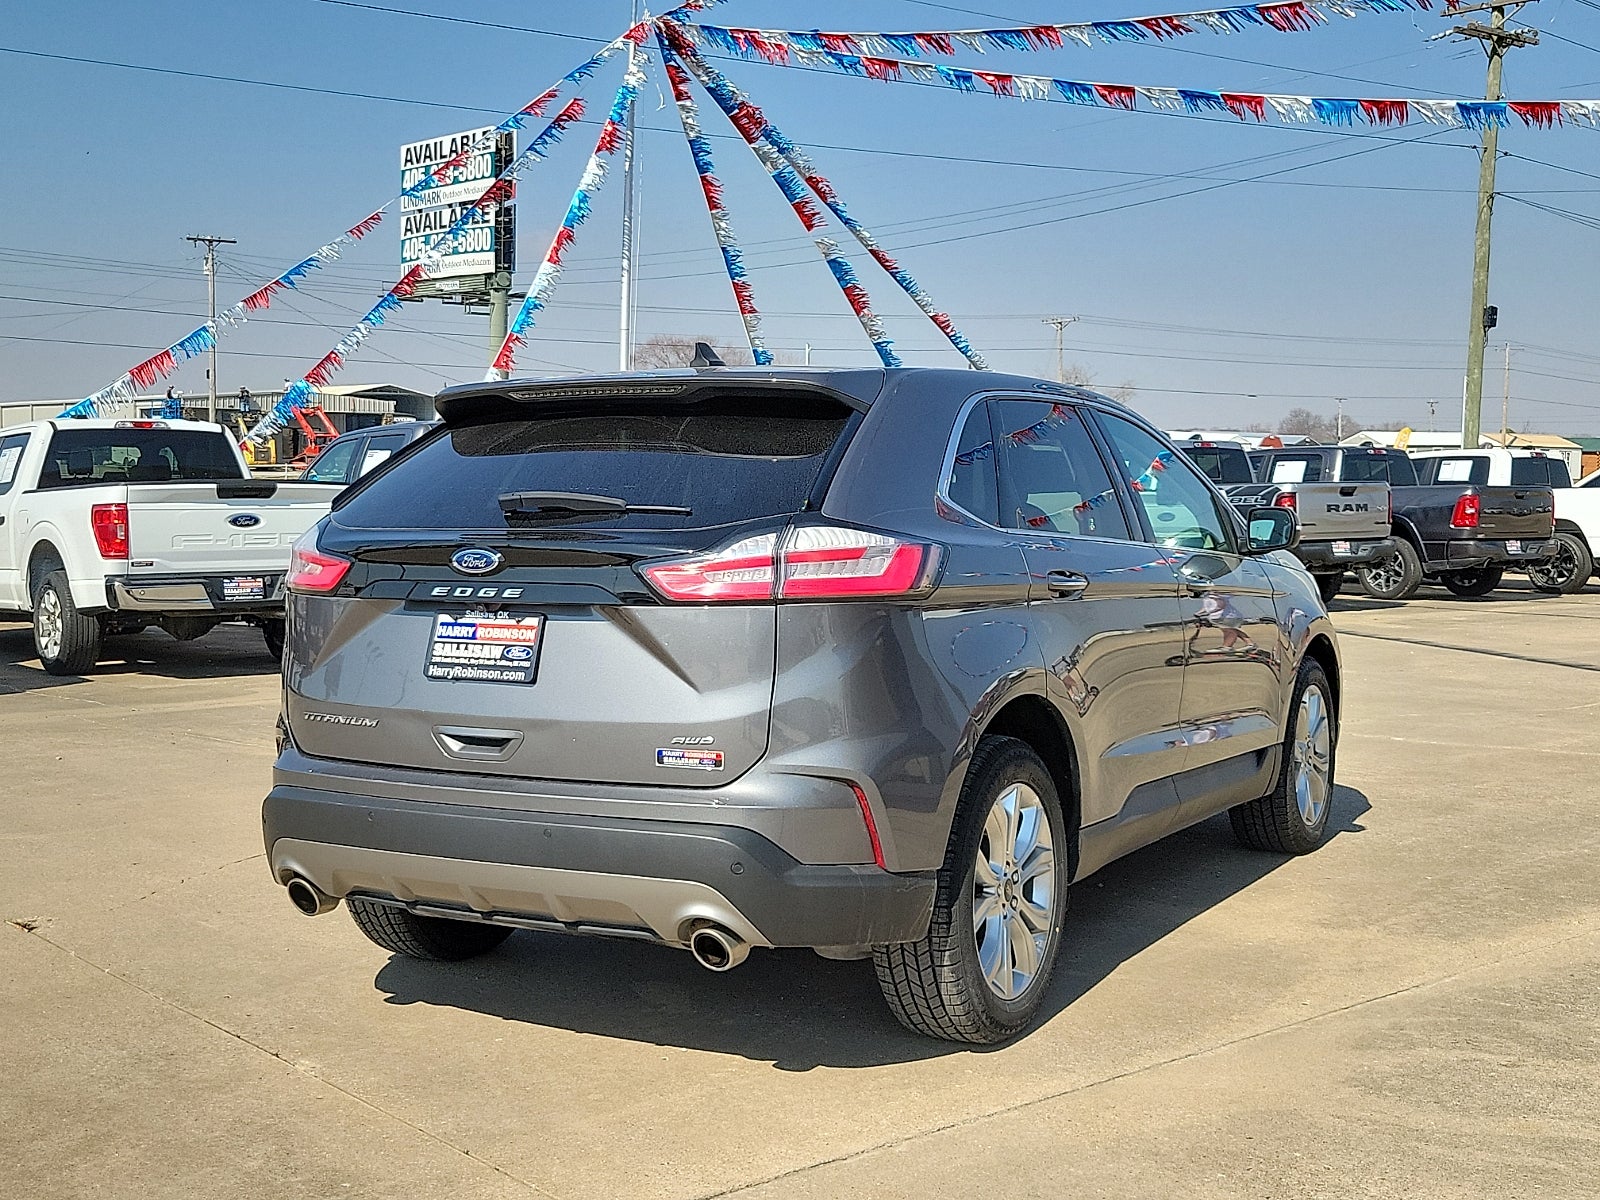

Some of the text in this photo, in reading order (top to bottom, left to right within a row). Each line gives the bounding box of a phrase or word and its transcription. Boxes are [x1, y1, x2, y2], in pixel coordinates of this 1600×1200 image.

[404, 129, 492, 167] AVAILABLE
[1326, 503, 1369, 513] RAM
[461, 553, 487, 568] Ford
[430, 586, 524, 598] EDGE
[497, 611, 510, 619] OK
[437, 625, 538, 640] HARRY ROBINSON
[432, 642, 506, 659] SALLISAW
[428, 664, 526, 681] HarryRobinson.com
[303, 711, 380, 728] TITANIUM
[671, 735, 715, 745] AWD
